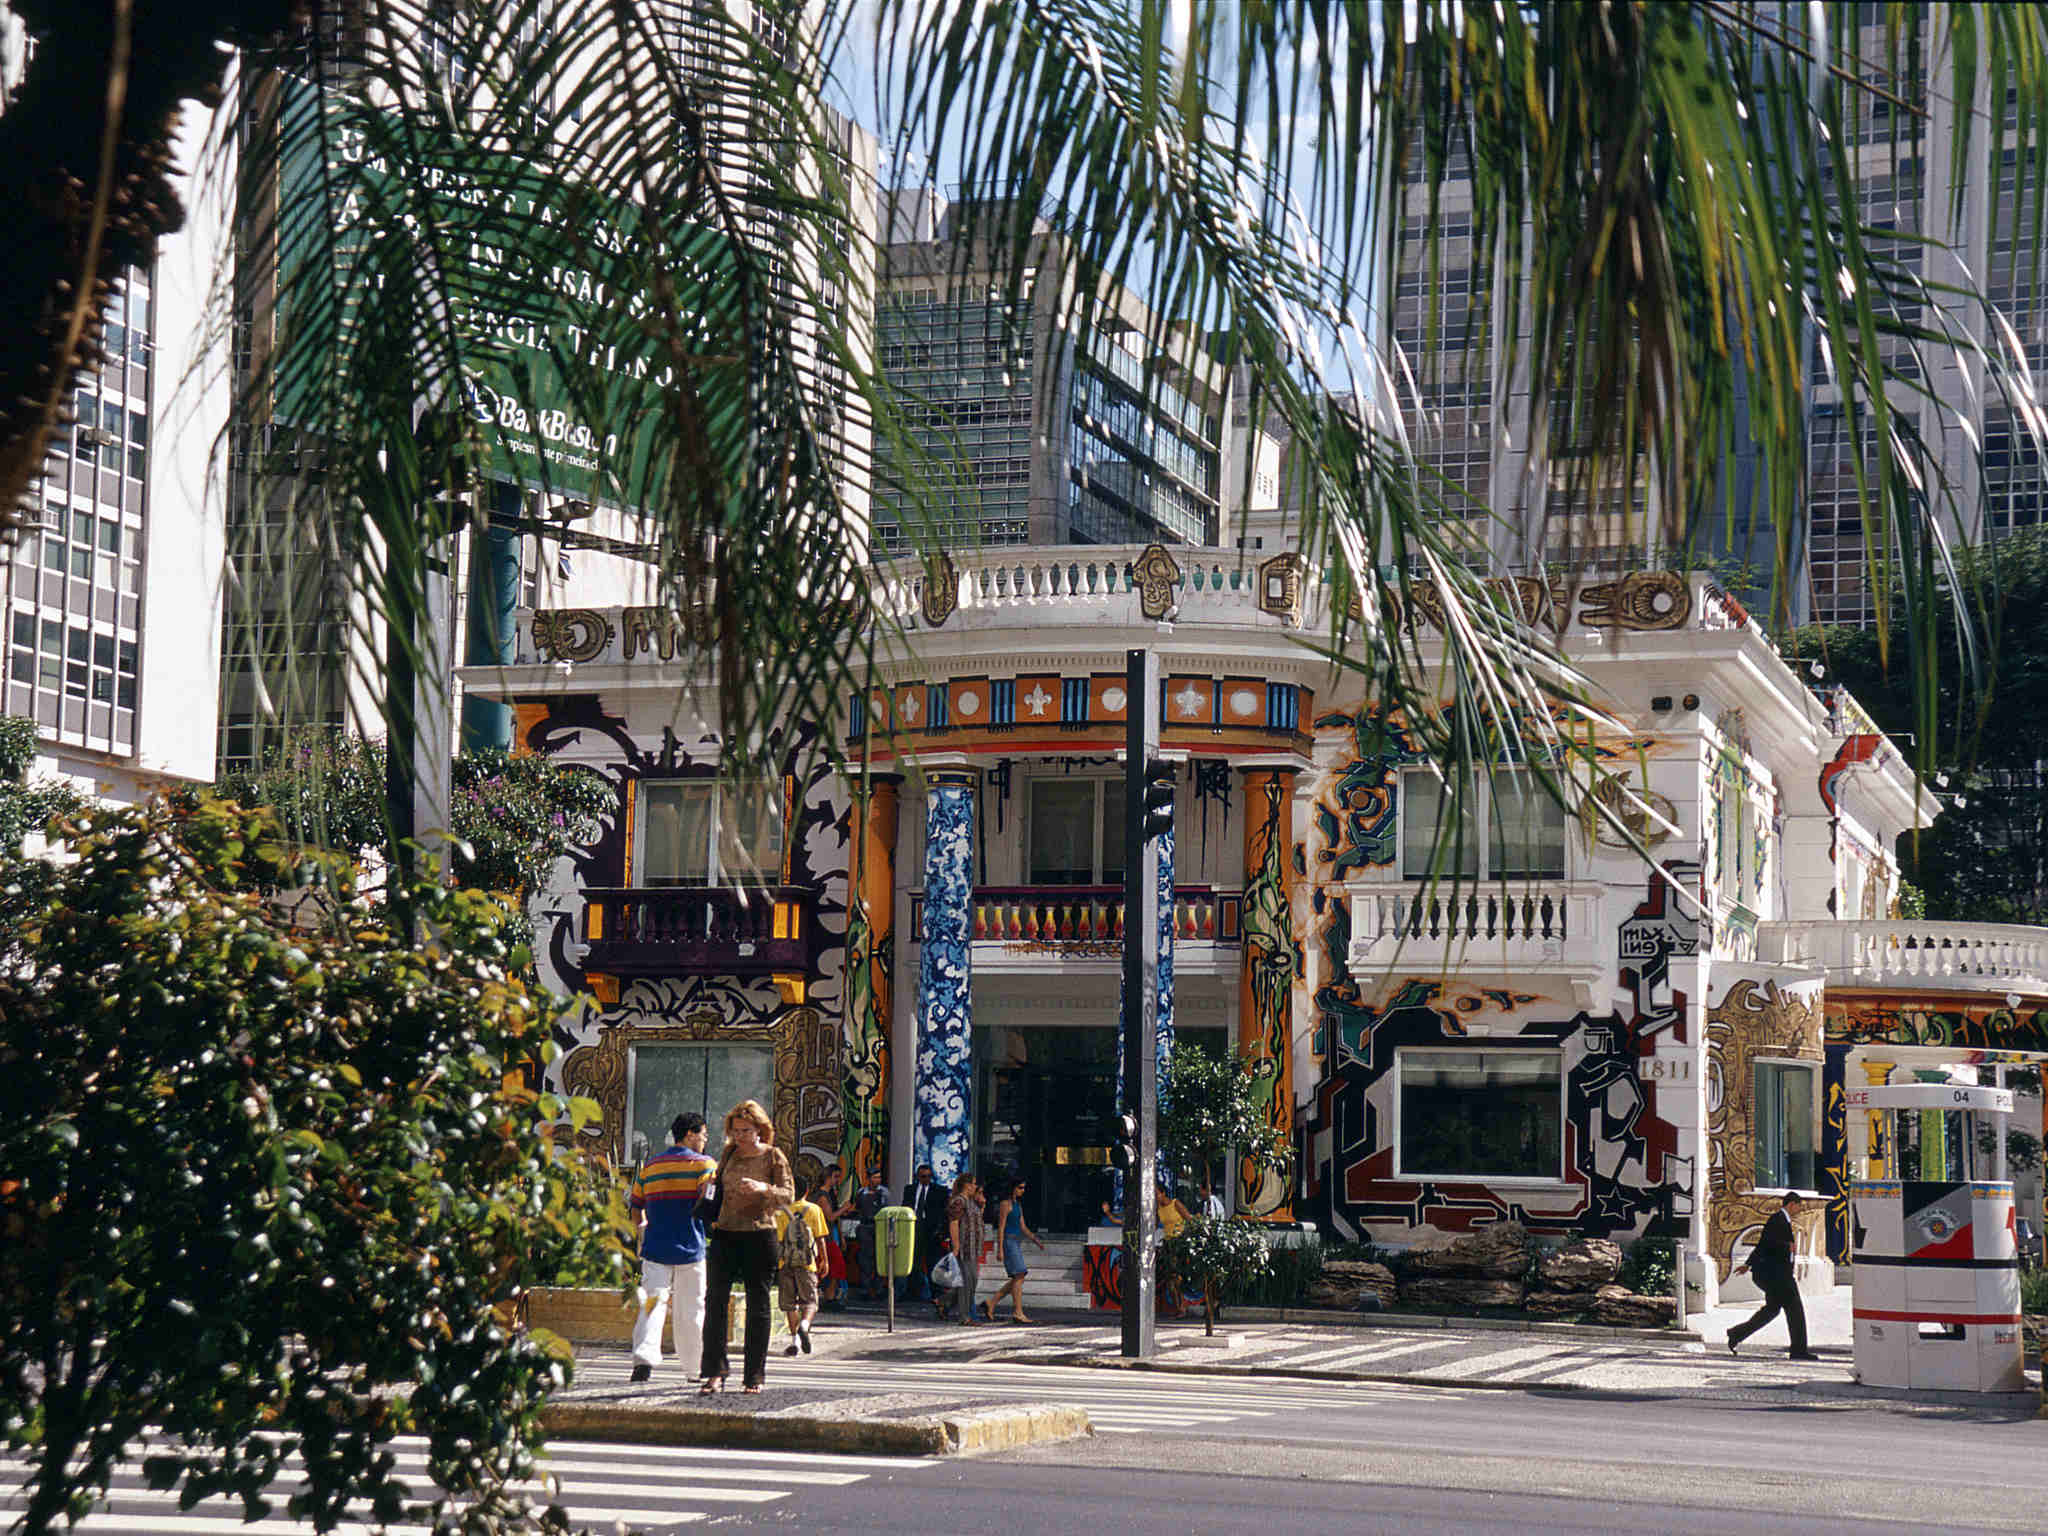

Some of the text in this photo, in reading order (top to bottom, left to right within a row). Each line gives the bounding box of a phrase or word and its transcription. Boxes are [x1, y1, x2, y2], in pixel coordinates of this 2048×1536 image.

[499, 395, 617, 457] BakBostn
[1640, 1060, 1689, 1080] 1811
[1953, 1090, 1969, 1104] 04
